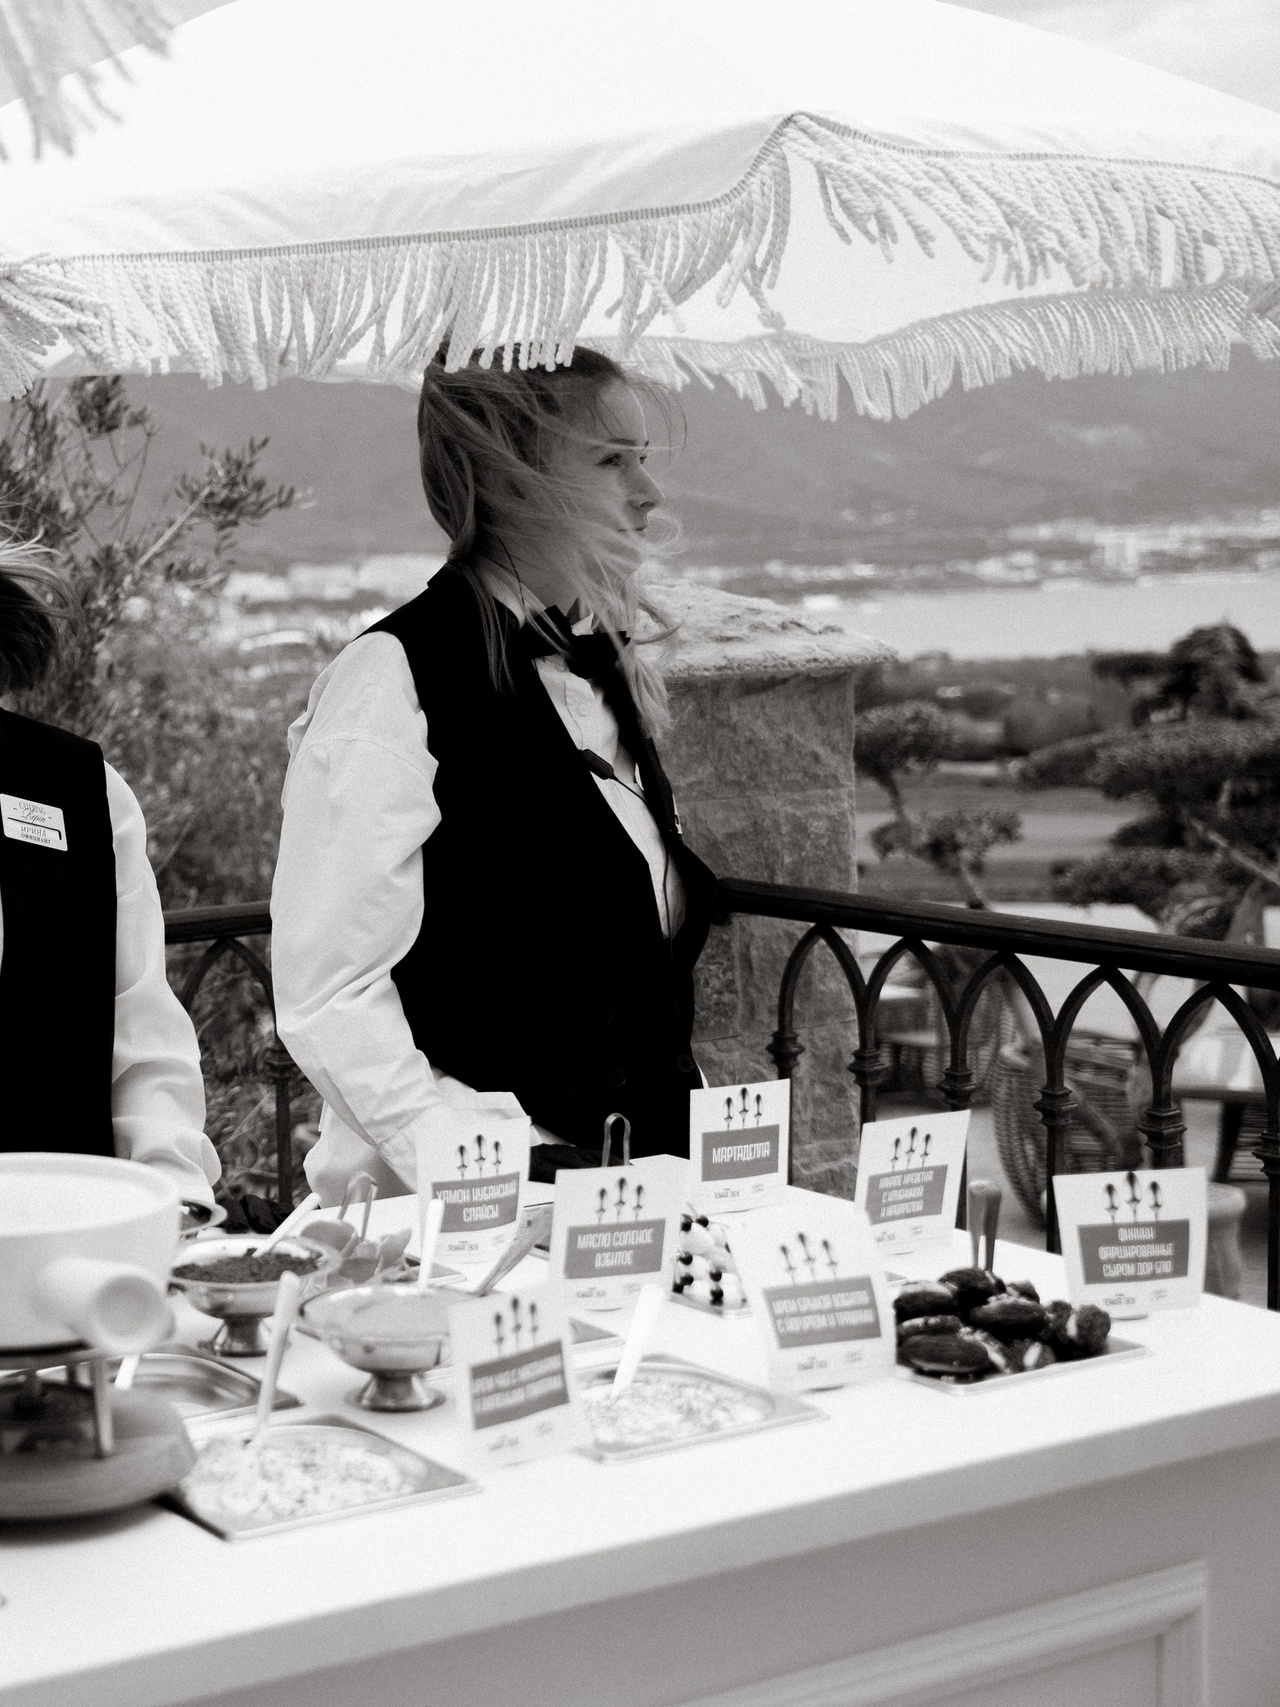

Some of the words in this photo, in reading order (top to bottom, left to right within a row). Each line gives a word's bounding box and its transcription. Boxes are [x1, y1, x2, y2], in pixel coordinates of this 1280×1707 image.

[21, 826, 47, 837] ИРИНА
[712, 1141, 770, 1163] МАРТАДЕЛЛА
[436, 1188, 470, 1204] ХАМОН
[472, 1180, 516, 1201] КУБАНСКИЙ
[881, 1191, 887, 1204] С
[462, 1204, 499, 1222] СПАЙСЫ
[880, 1206, 886, 1218] И
[577, 1232, 611, 1249] МАСЛО
[612, 1228, 653, 1246] СОЛЕНОЕ
[1117, 1227, 1154, 1242] ФИНИКИ
[594, 1250, 634, 1268] ВЗБИТОЕ
[1098, 1243, 1174, 1260] ФАРШИРОВАННЫЕ
[1102, 1263, 1135, 1277] СЫРОМ
[1136, 1262, 1153, 1276] ДОР
[1154, 1260, 1172, 1274] БЛЮ
[776, 1318, 785, 1333] С
